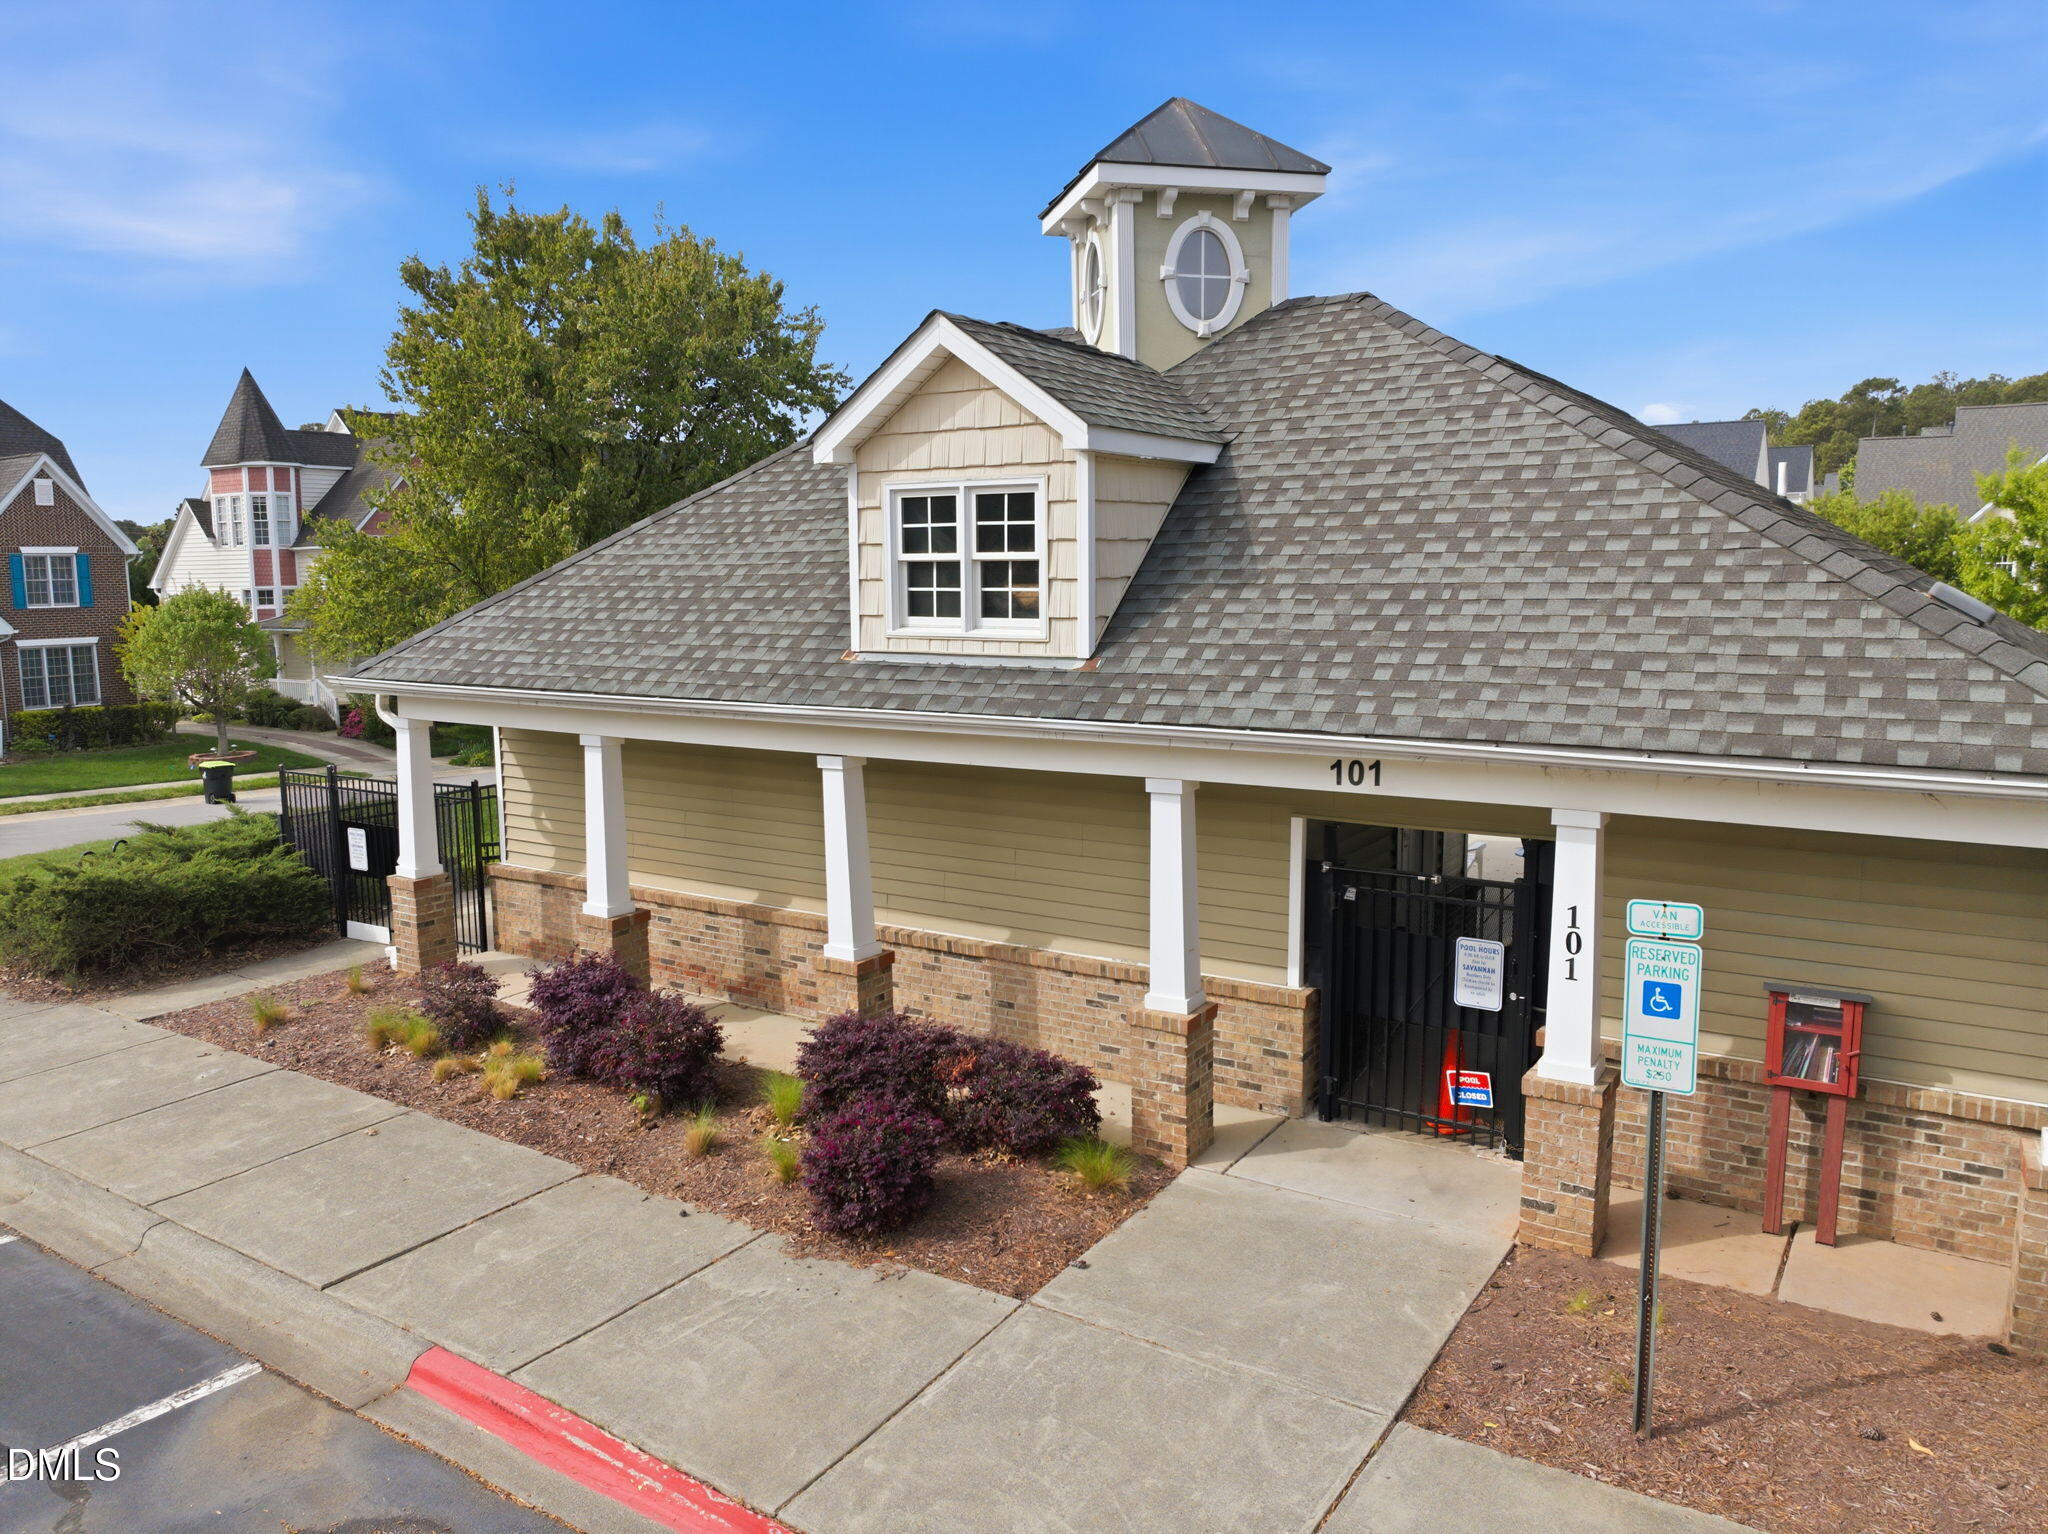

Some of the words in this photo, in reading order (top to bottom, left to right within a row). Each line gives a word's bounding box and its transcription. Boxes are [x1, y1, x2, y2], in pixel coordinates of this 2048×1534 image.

[1330, 759, 1381, 787] 101
[1653, 910, 1678, 921] VAN
[1640, 920, 1690, 931] ACCESSIBLE
[1460, 944, 1477, 952] POOL
[1479, 946, 1500, 956] HOURS
[1565, 905, 1582, 981] 101
[1632, 945, 1696, 965] RESERVED
[1462, 963, 1496, 974] SAVANNAH
[1637, 962, 1690, 981] PARKING
[1637, 1043, 1682, 1058] MAXIMUM
[1637, 1056, 1680, 1070] PENALTY
[1459, 1076, 1481, 1085] POOL
[1646, 1068, 1672, 1082] $250
